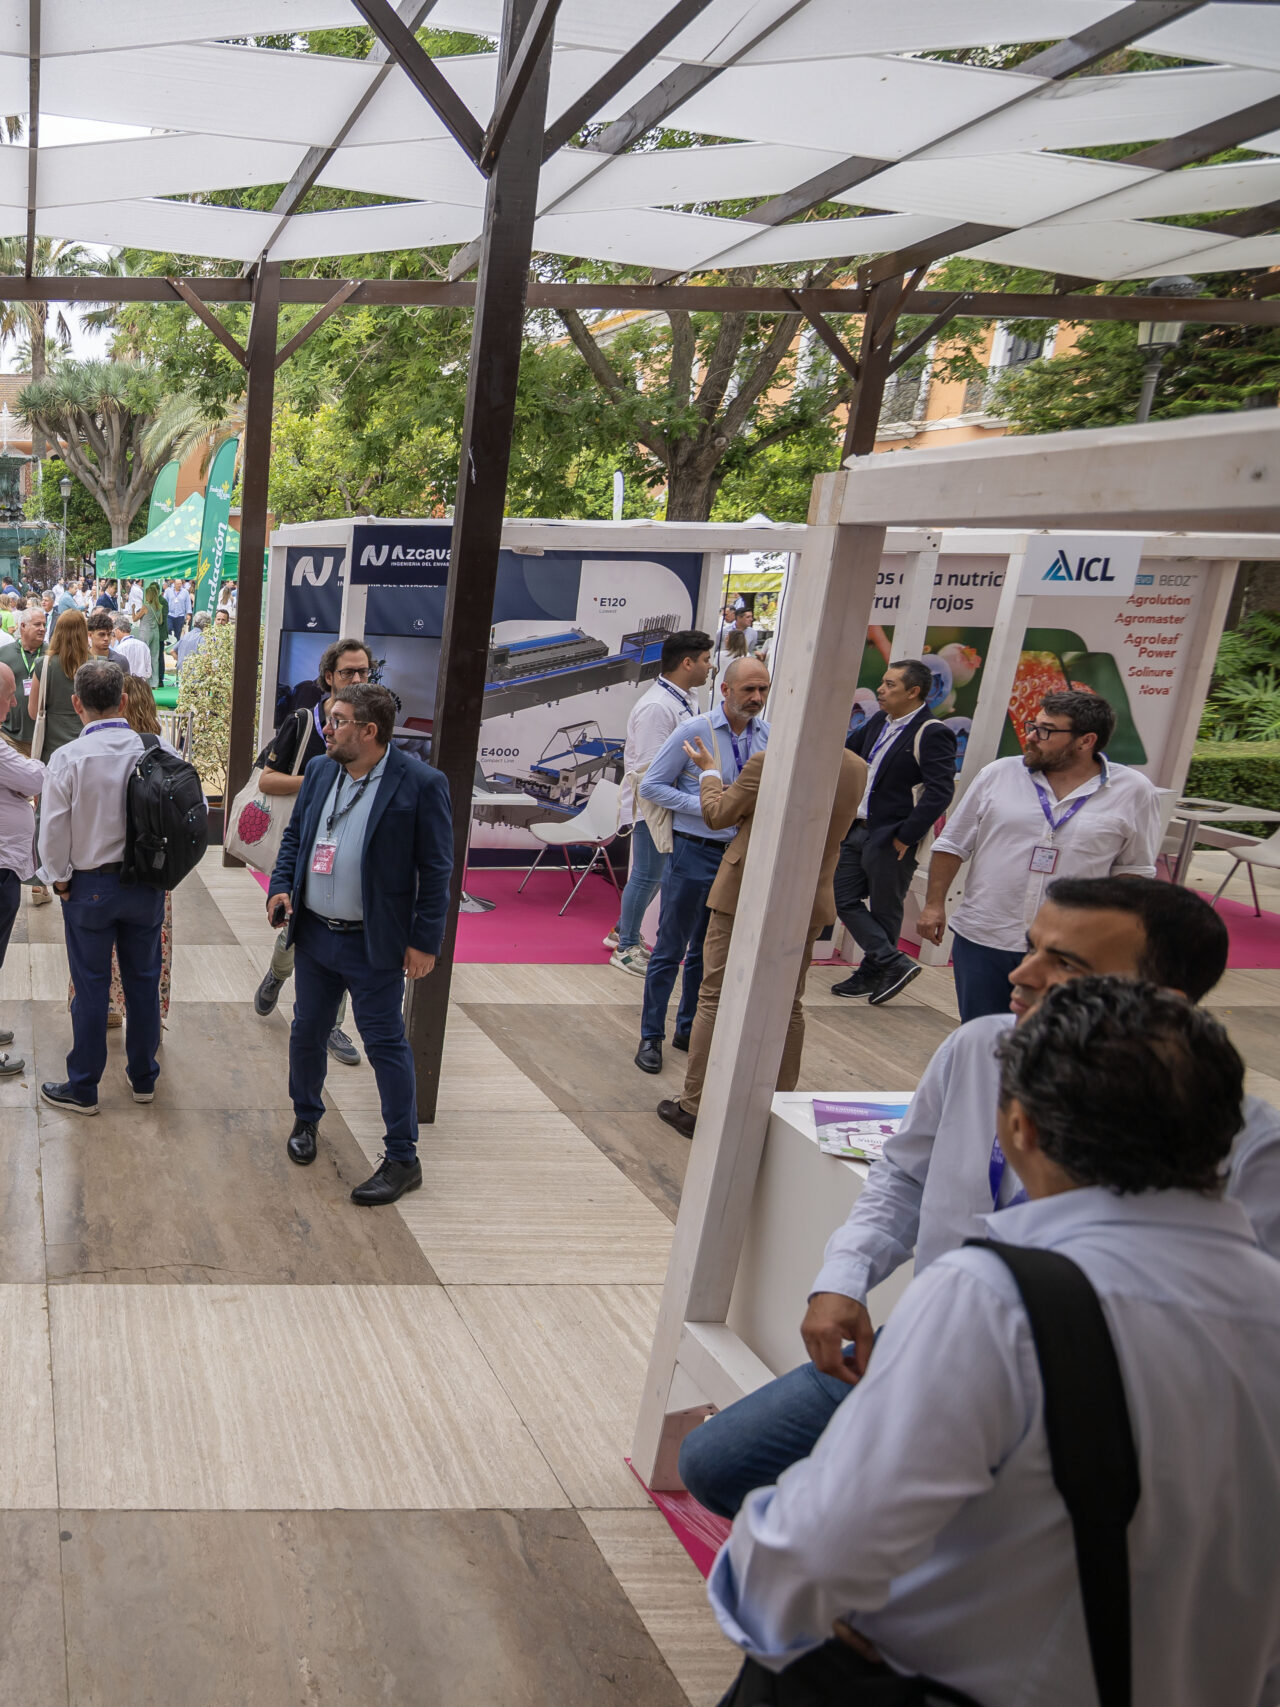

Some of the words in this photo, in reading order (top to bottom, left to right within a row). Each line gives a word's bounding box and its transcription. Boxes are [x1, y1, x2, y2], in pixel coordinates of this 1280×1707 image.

[391, 545, 452, 561] Azcava
[1075, 557, 1116, 582] ICL
[599, 597, 627, 607] E120
[929, 594, 974, 613] rojos
[1126, 594, 1191, 608] Agrolution
[1114, 612, 1186, 626] Agromaster
[1123, 632, 1181, 648] Agroleaf
[1138, 646, 1177, 658] Power
[1127, 666, 1174, 678] Solinure
[1138, 684, 1170, 695] Nova
[481, 747, 520, 757] E4000
